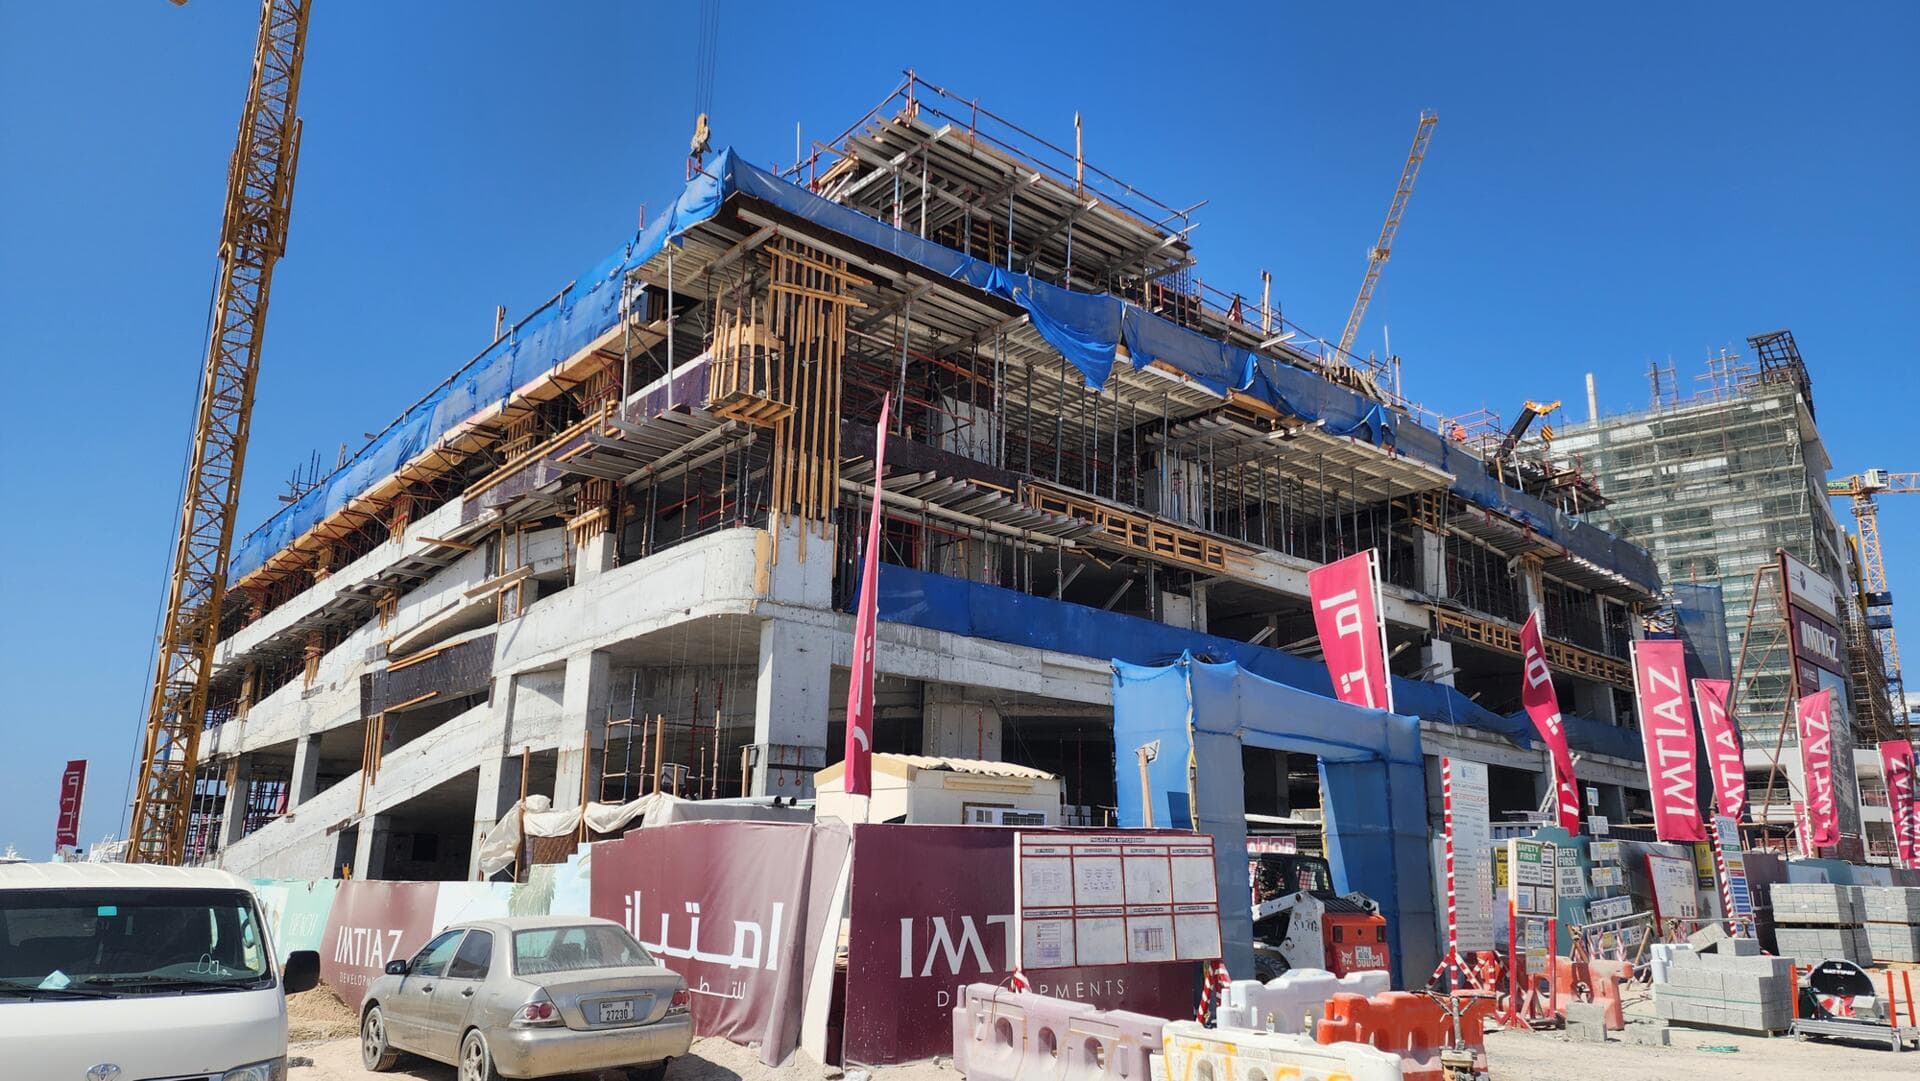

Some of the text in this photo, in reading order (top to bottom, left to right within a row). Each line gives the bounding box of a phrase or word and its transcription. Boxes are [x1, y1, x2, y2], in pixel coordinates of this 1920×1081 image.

[1648, 666, 1696, 817] IMTIAZ
[1708, 700, 1744, 817] MTIAZ
[1518, 843, 1539, 853] SAFETY
[1519, 852, 1537, 862] FIRST
[1558, 857, 1577, 866] FIRST
[334, 925, 404, 969] IMTIAZ
[606, 1009, 629, 1021] 27230
